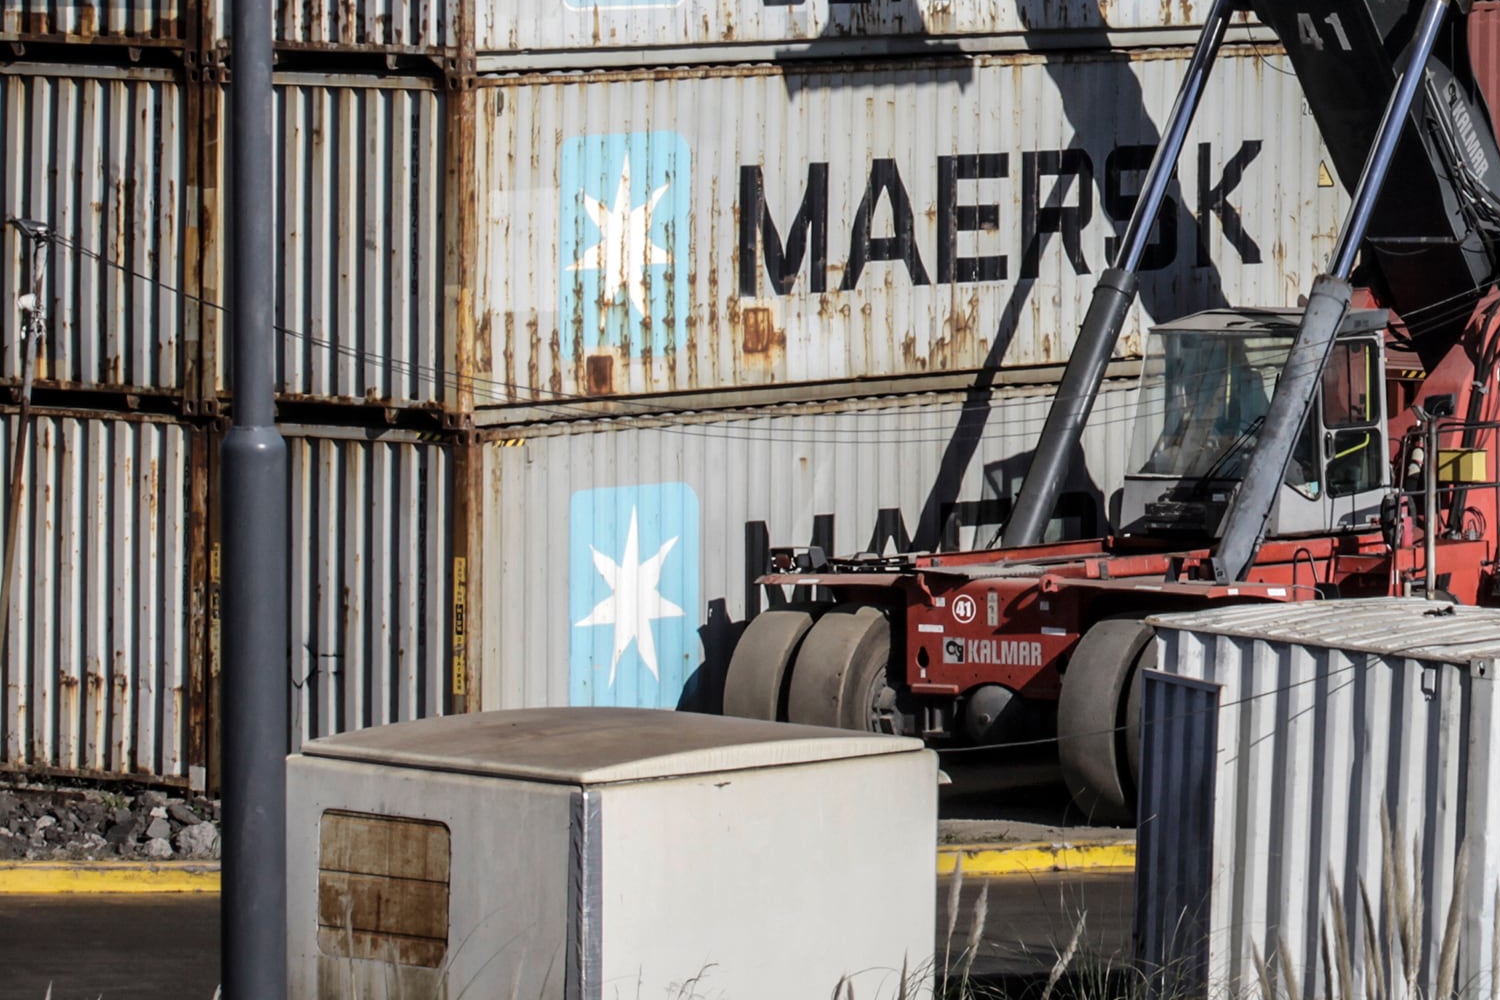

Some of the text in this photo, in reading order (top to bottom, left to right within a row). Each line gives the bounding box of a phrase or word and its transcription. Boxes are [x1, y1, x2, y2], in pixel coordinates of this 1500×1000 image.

[1297, 13, 1352, 50] 41
[1452, 99, 1489, 179] KALMAR
[739, 140, 1262, 297] MAERSK
[956, 601, 972, 617] 41
[968, 639, 1042, 666] KALMAR
